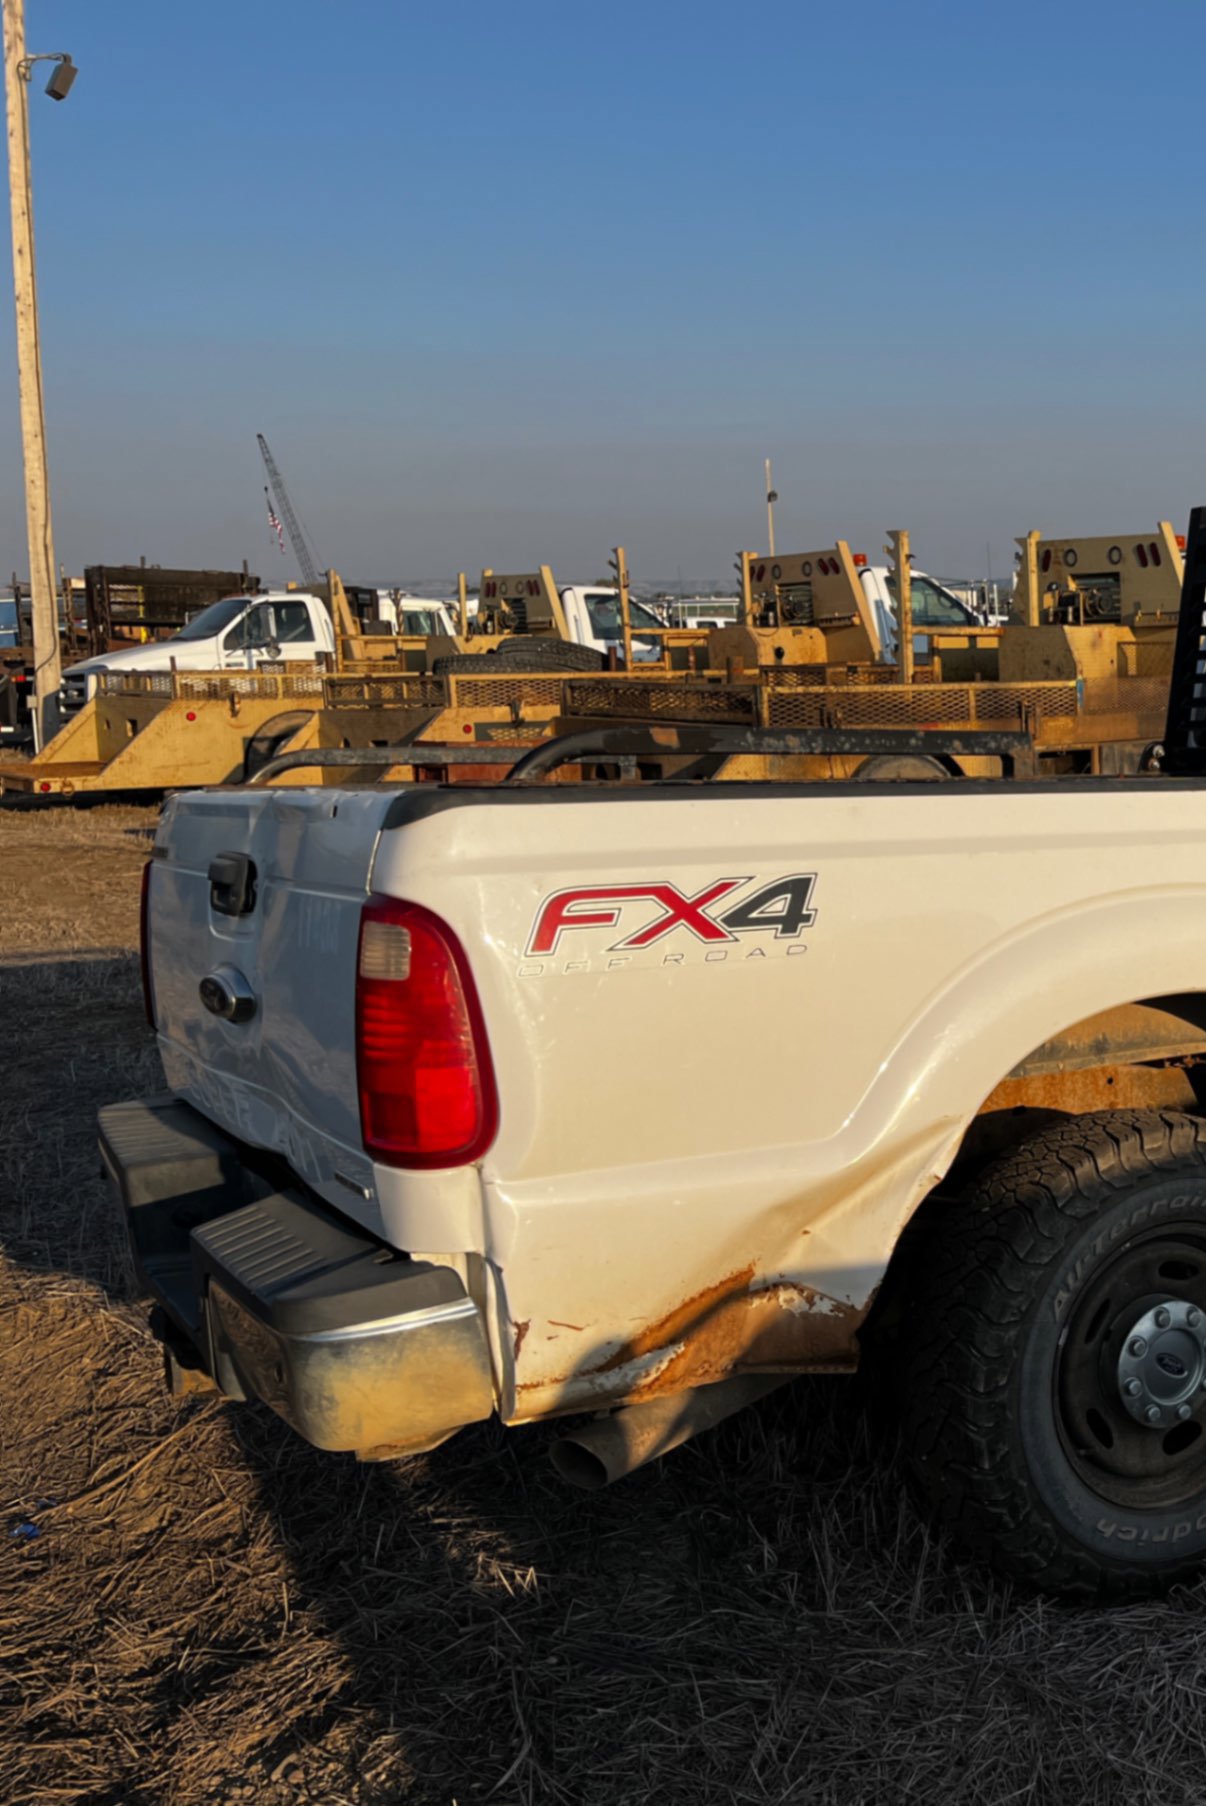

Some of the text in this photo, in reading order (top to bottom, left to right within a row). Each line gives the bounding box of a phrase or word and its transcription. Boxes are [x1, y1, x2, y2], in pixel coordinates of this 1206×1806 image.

[524, 872, 818, 957] FX4
[518, 944, 809, 977] OFF ROAD
